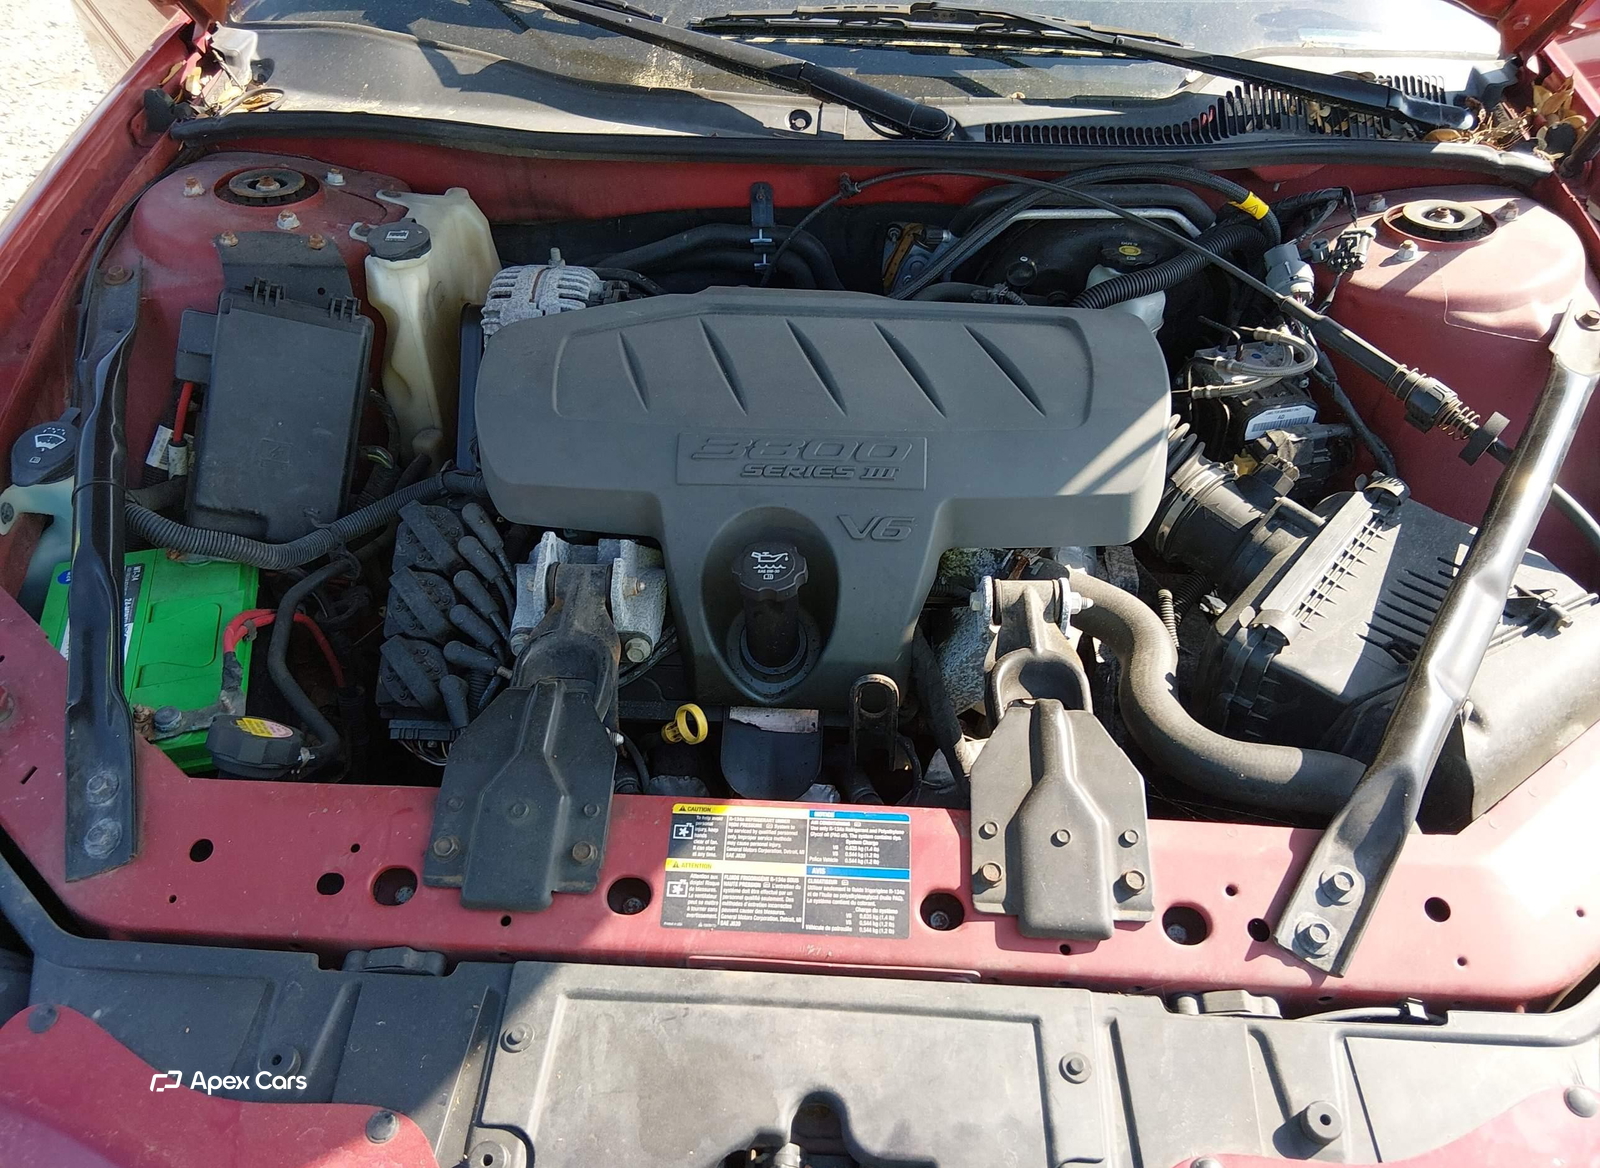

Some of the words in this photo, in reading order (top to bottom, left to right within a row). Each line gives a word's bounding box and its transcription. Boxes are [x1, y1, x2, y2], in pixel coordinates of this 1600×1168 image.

[691, 437, 913, 462] 3800
[740, 464, 856, 480] SERIES
[860, 465, 900, 481] III
[837, 514, 916, 542] V6
